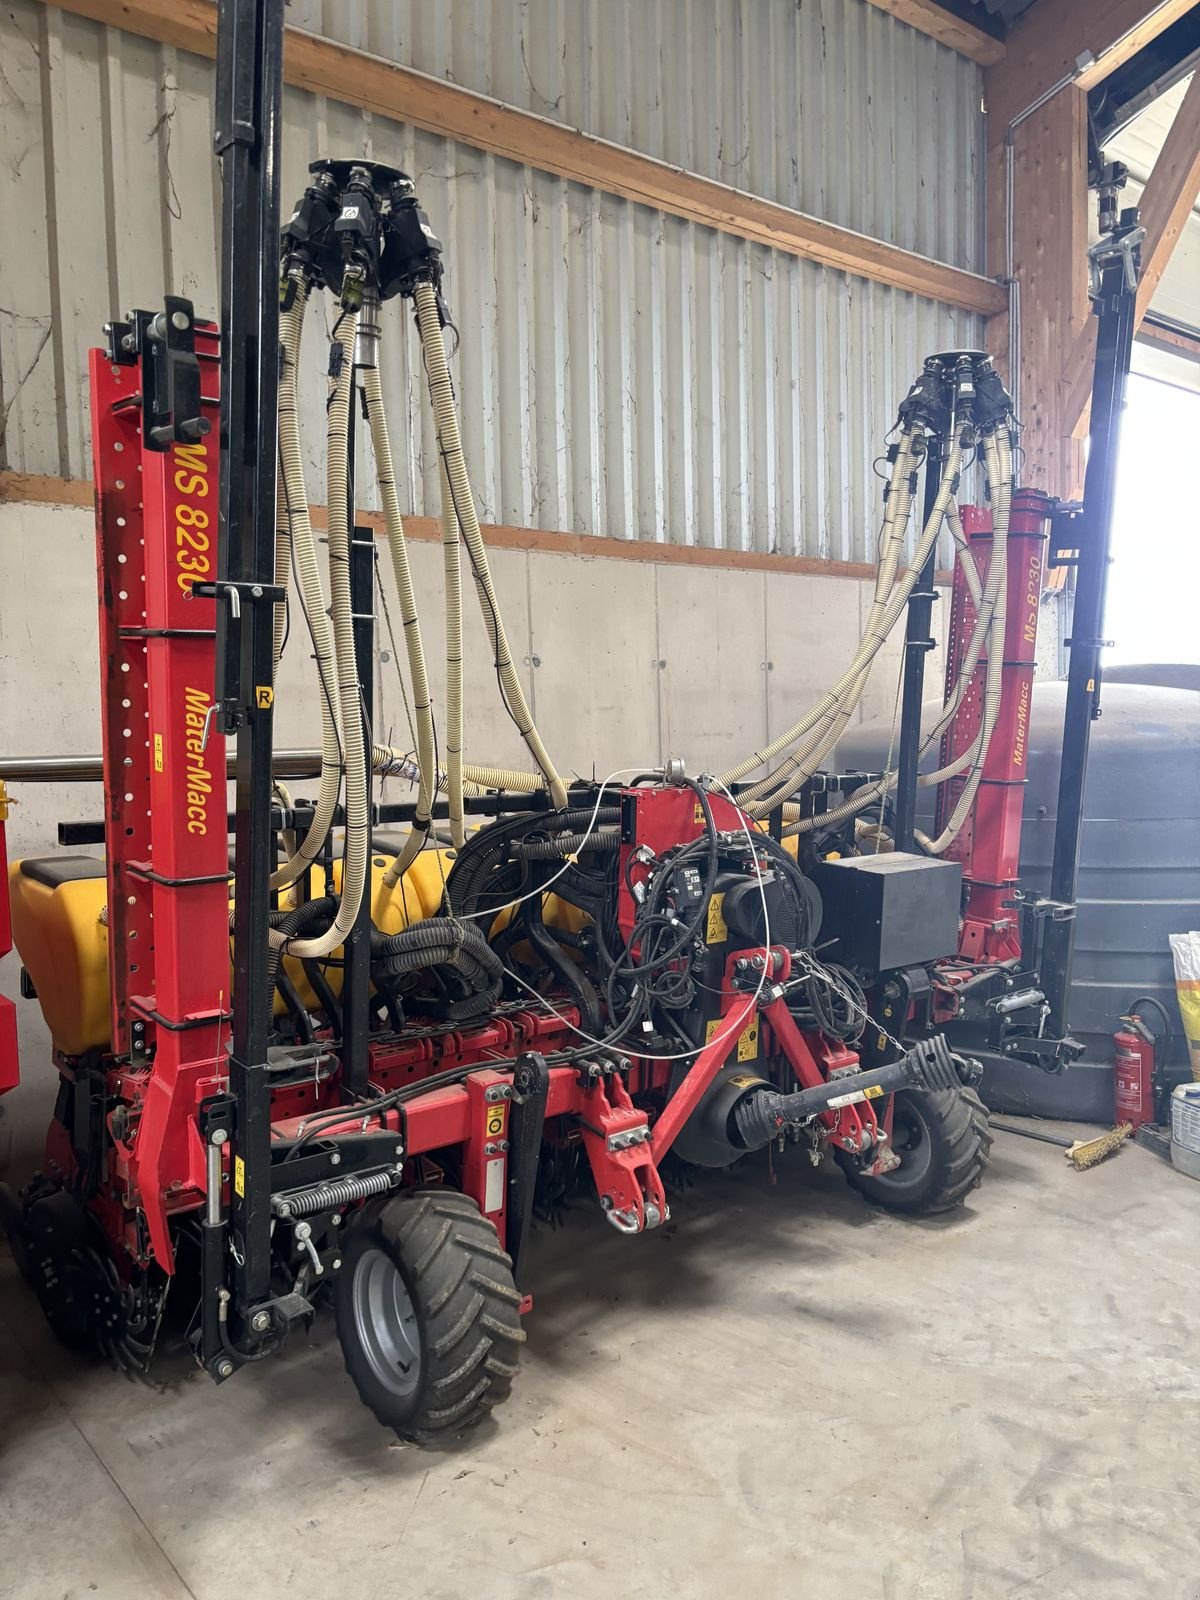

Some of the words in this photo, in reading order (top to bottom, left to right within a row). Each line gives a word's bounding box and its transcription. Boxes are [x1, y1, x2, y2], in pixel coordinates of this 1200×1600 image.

[174, 443, 209, 497] MS
[259, 690, 270, 703] R
[1013, 681, 1029, 766] MaterMacc
[185, 686, 212, 836] MaterMacc
